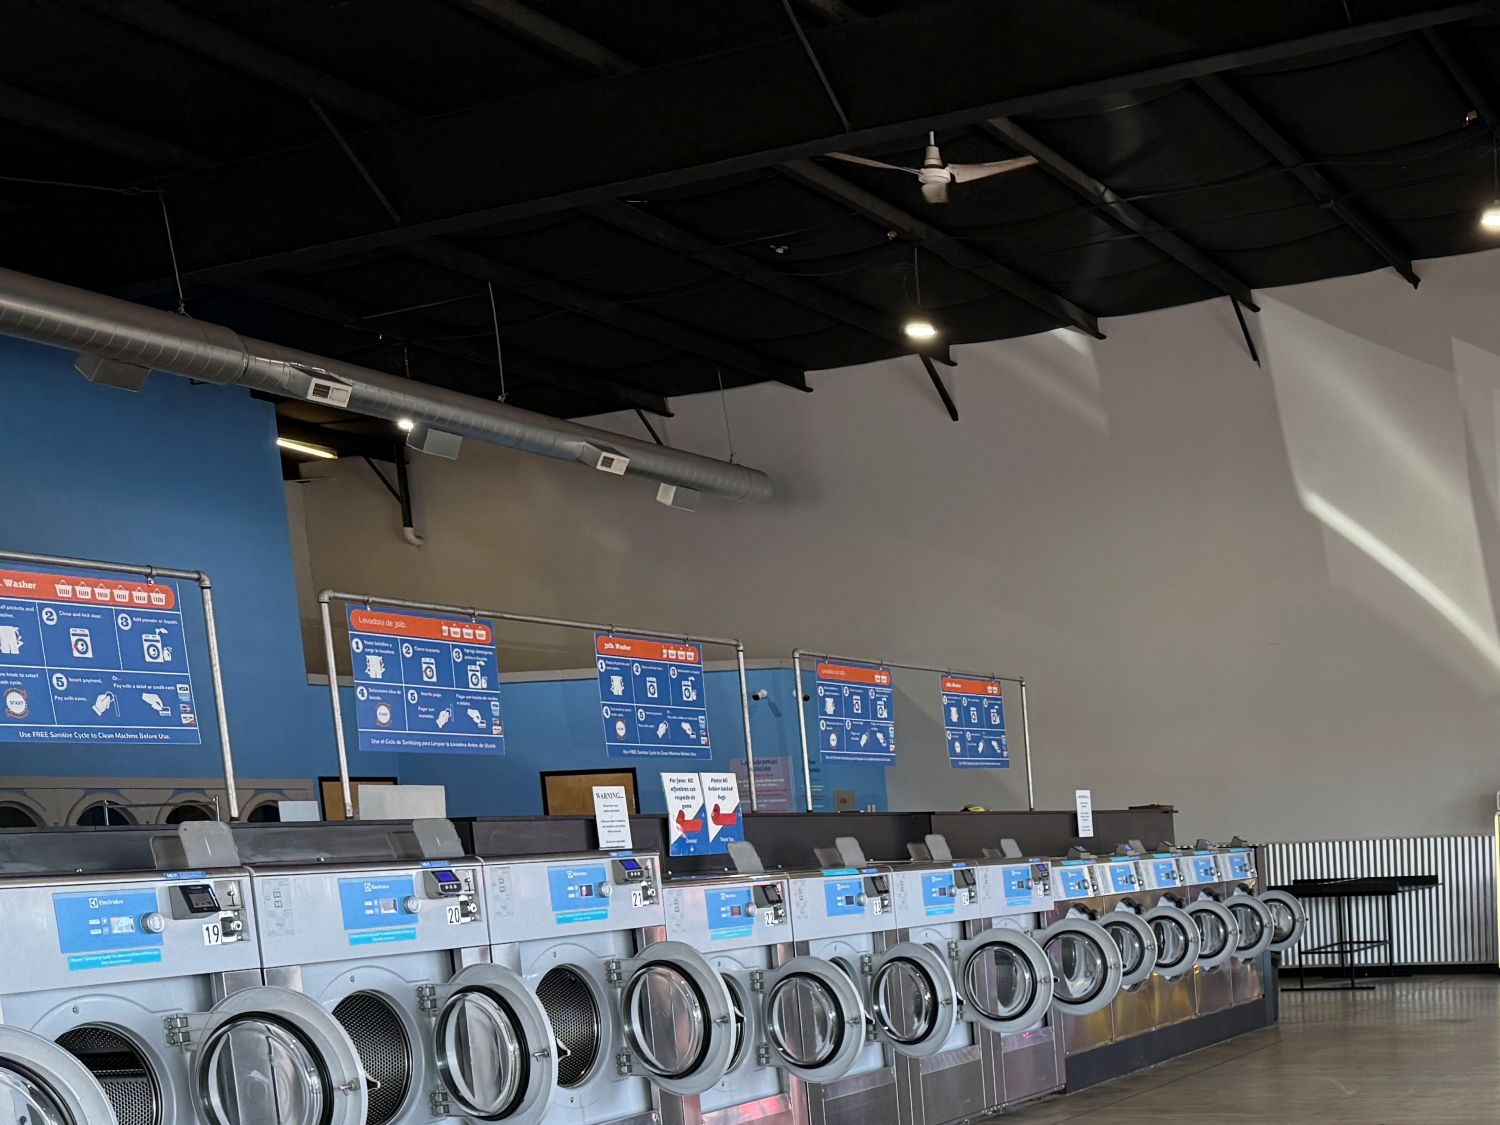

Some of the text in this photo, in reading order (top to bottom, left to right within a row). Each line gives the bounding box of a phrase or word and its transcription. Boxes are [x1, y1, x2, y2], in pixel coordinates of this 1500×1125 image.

[3, 578, 37, 589] Washer
[45, 611, 55, 621] 2
[358, 616, 385, 626] Lavadora
[120, 616, 129, 627] 3
[404, 646, 411, 655] 2
[454, 650, 461, 660] 3
[55, 677, 65, 687] 5
[358, 688, 365, 698] 4
[410, 692, 416, 702] 5
[448, 907, 460, 924] 20
[766, 912, 775, 925] 22
[205, 925, 220, 944] 19
